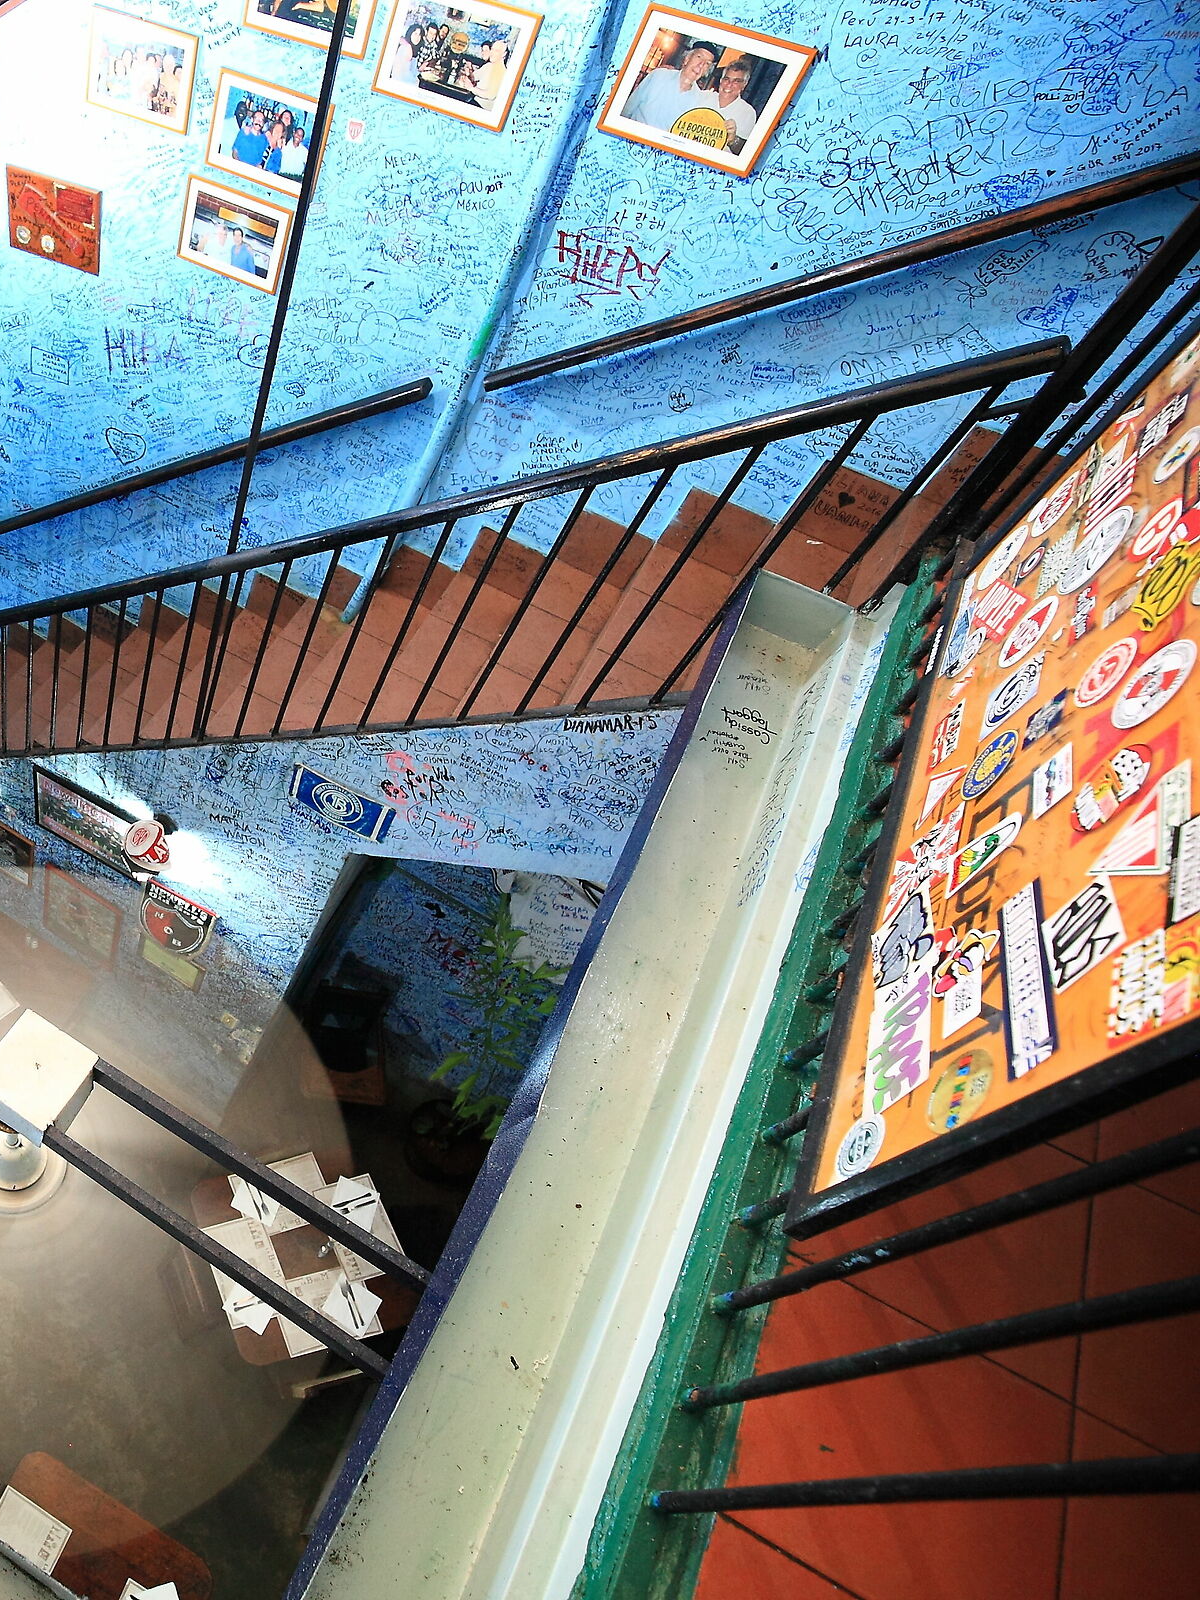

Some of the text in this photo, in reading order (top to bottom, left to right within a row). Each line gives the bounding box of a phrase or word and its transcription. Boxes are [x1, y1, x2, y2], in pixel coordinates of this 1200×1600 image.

[844, 31, 899, 48] LAURA
[1062, 91, 1085, 102] 2017
[686, 122, 724, 139] BODEGUITA
[1136, 143, 1163, 157] 2017
[1002, 169, 1039, 185] 2017
[720, 706, 778, 736] Taggart
[723, 713, 770, 745] Cassidy
[870, 970, 931, 1115] TRACE
